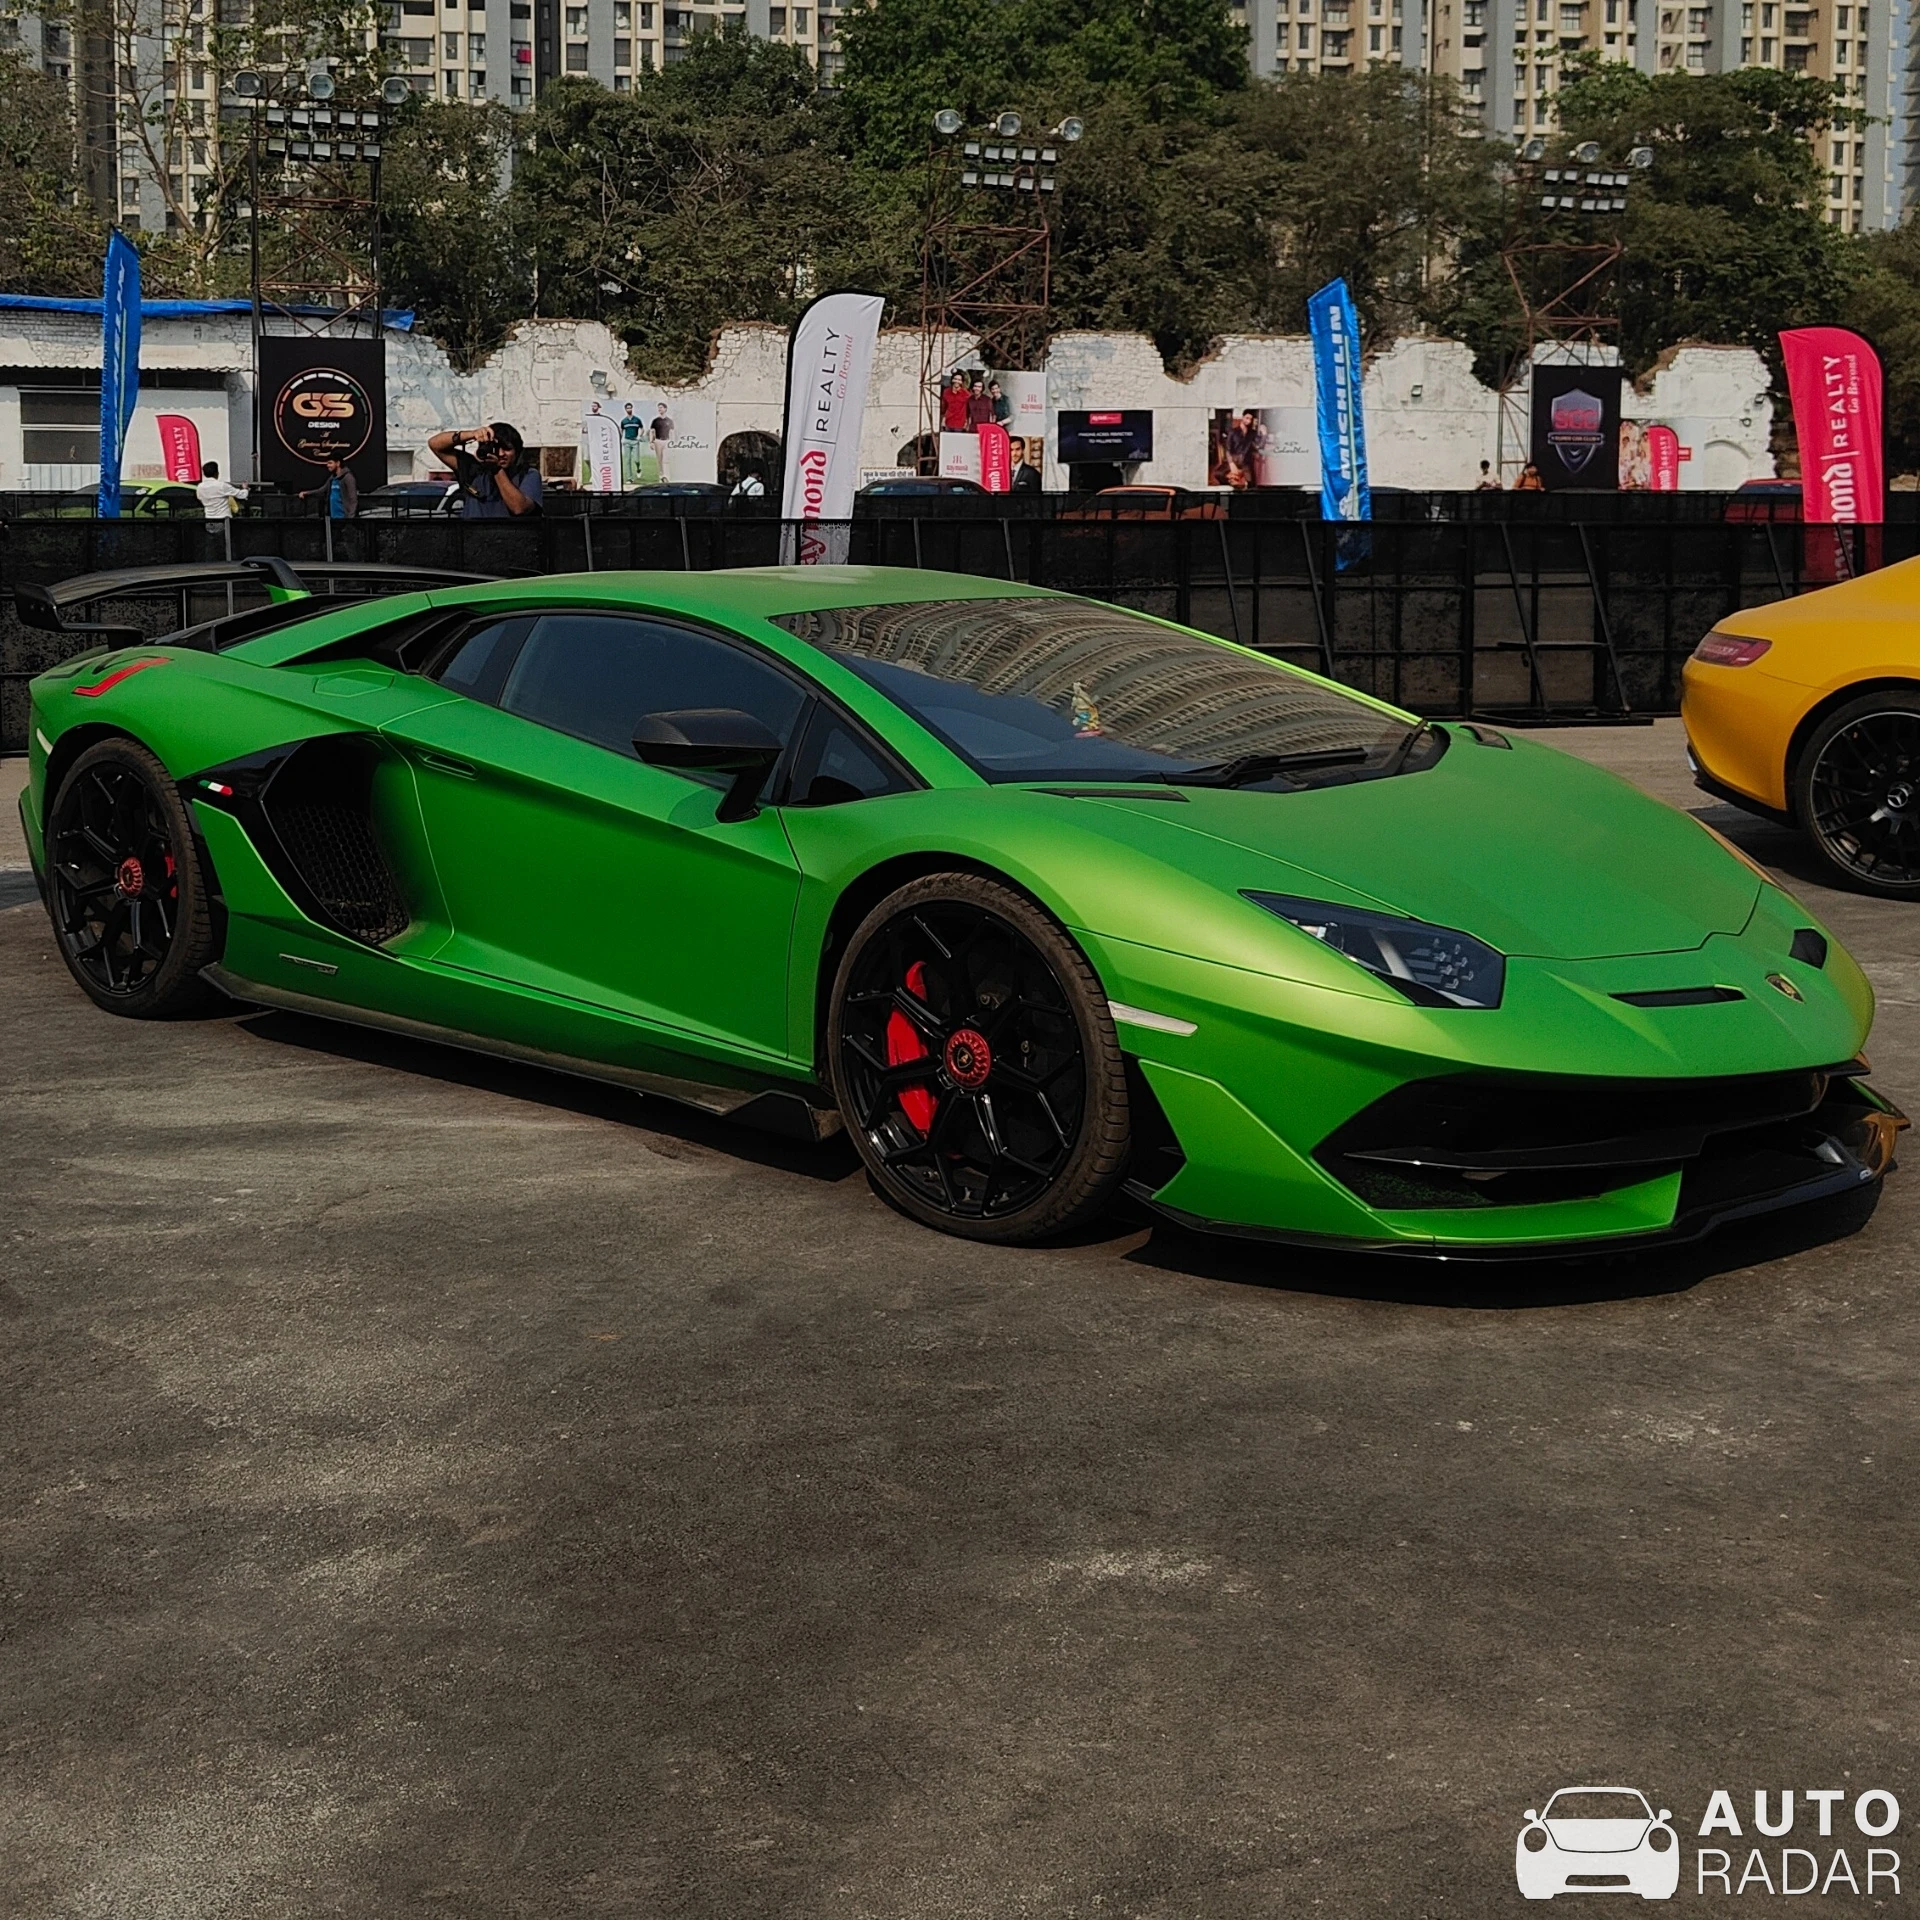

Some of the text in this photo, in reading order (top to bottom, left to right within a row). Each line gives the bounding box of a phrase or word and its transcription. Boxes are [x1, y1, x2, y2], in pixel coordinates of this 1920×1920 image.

[815, 327, 841, 432] REALTY
[836, 333, 853, 400] Go Beyond
[1844, 354, 1860, 414] Go Beyond
[292, 392, 355, 418] GS
[1329, 305, 1352, 480] MICHELIN
[1822, 355, 1849, 448] REALTY
[307, 421, 340, 429] DESIGN
[172, 426, 186, 464] REALTY
[601, 426, 610, 461] REALTY
[667, 440, 709, 449] ColorPlus
[990, 433, 999, 467] REALTY
[1273, 446, 1309, 454] ColorPlus
